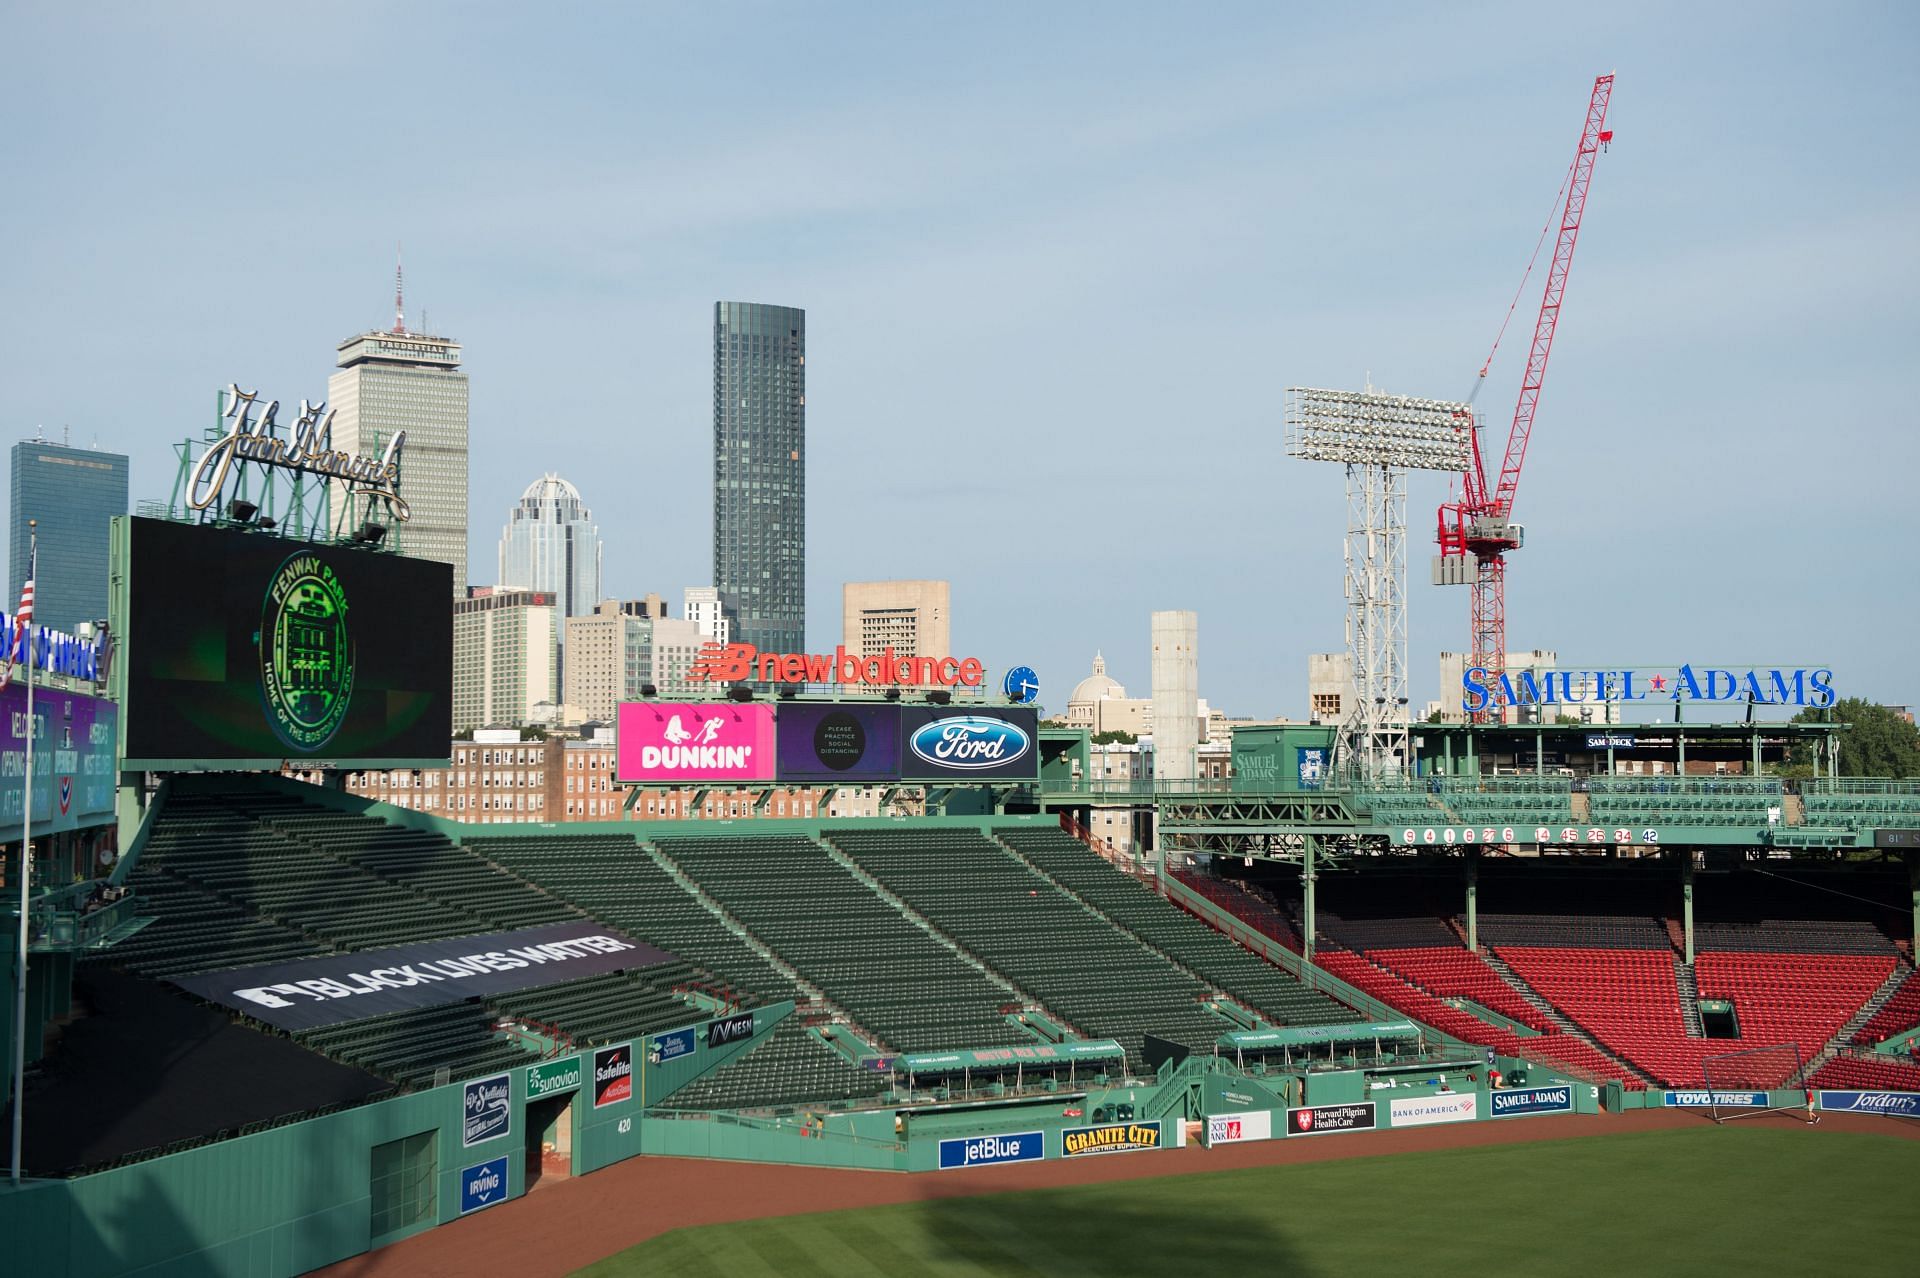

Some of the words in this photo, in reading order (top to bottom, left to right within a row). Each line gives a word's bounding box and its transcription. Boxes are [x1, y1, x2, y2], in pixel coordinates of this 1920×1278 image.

[380, 341, 445, 353] PRUDENTIAL
[186, 384, 283, 510] John
[283, 400, 411, 522] Hancock
[272, 557, 321, 605] FENWAY
[322, 565, 349, 618] PARK
[758, 652, 834, 684] new
[836, 644, 983, 686] balance
[1462, 666, 1645, 712] SAMUEL
[1671, 663, 1835, 710] ADAMS
[264, 661, 280, 708] HOME
[277, 708, 290, 724] OF
[288, 722, 305, 741] THE
[12, 711, 37, 738] WELCE
[935, 724, 1007, 758] Ford
[1588, 738, 1605, 748] SAM
[1608, 738, 1632, 747] DECK
[641, 745, 752, 769] DUNKIN'
[1236, 753, 1279, 771] SAMUEL
[1240, 768, 1276, 785] ADAMS
[1406, 829, 1413, 841] 9
[1426, 829, 1433, 841] 4
[1447, 829, 1452, 841] 1
[1466, 829, 1473, 841] 8
[1482, 828, 1496, 841] 27
[1505, 829, 1512, 841] 6
[1535, 828, 1549, 841] 14
[1560, 828, 1578, 841] 45
[1587, 828, 1605, 841] 26
[1614, 828, 1632, 841] 34
[1642, 828, 1657, 841] 42
[295, 964, 445, 999] BLACK
[418, 951, 529, 979] LIVES
[507, 935, 636, 965] MATTER
[731, 1018, 752, 1037] NESN
[539, 1069, 579, 1093] sunovion
[597, 1061, 630, 1082] Safelite
[1495, 1094, 1531, 1110] SAMUEL
[1534, 1089, 1567, 1104] ADAMS
[1675, 1093, 1712, 1104] TOYO
[1712, 1093, 1754, 1104] TIRES
[1847, 1092, 1917, 1110] Jordan's
[1314, 1107, 1342, 1120] Harvard
[1342, 1107, 1366, 1119] Pilgrim
[1392, 1109, 1413, 1118] BANK
[1414, 1108, 1424, 1116] OF
[1425, 1105, 1458, 1115] AMERICA
[618, 1118, 631, 1134] 420
[1314, 1118, 1337, 1129] Health
[1337, 1117, 1354, 1127] Care
[1065, 1126, 1126, 1153] GRANITE
[1128, 1124, 1159, 1145] CITY
[1211, 1132, 1226, 1140] ANK
[963, 1137, 1020, 1166] jetBlue
[1083, 1144, 1116, 1153] ELECTRIC
[1116, 1142, 1141, 1150] SUPPLY
[469, 1173, 499, 1196] IRVING
